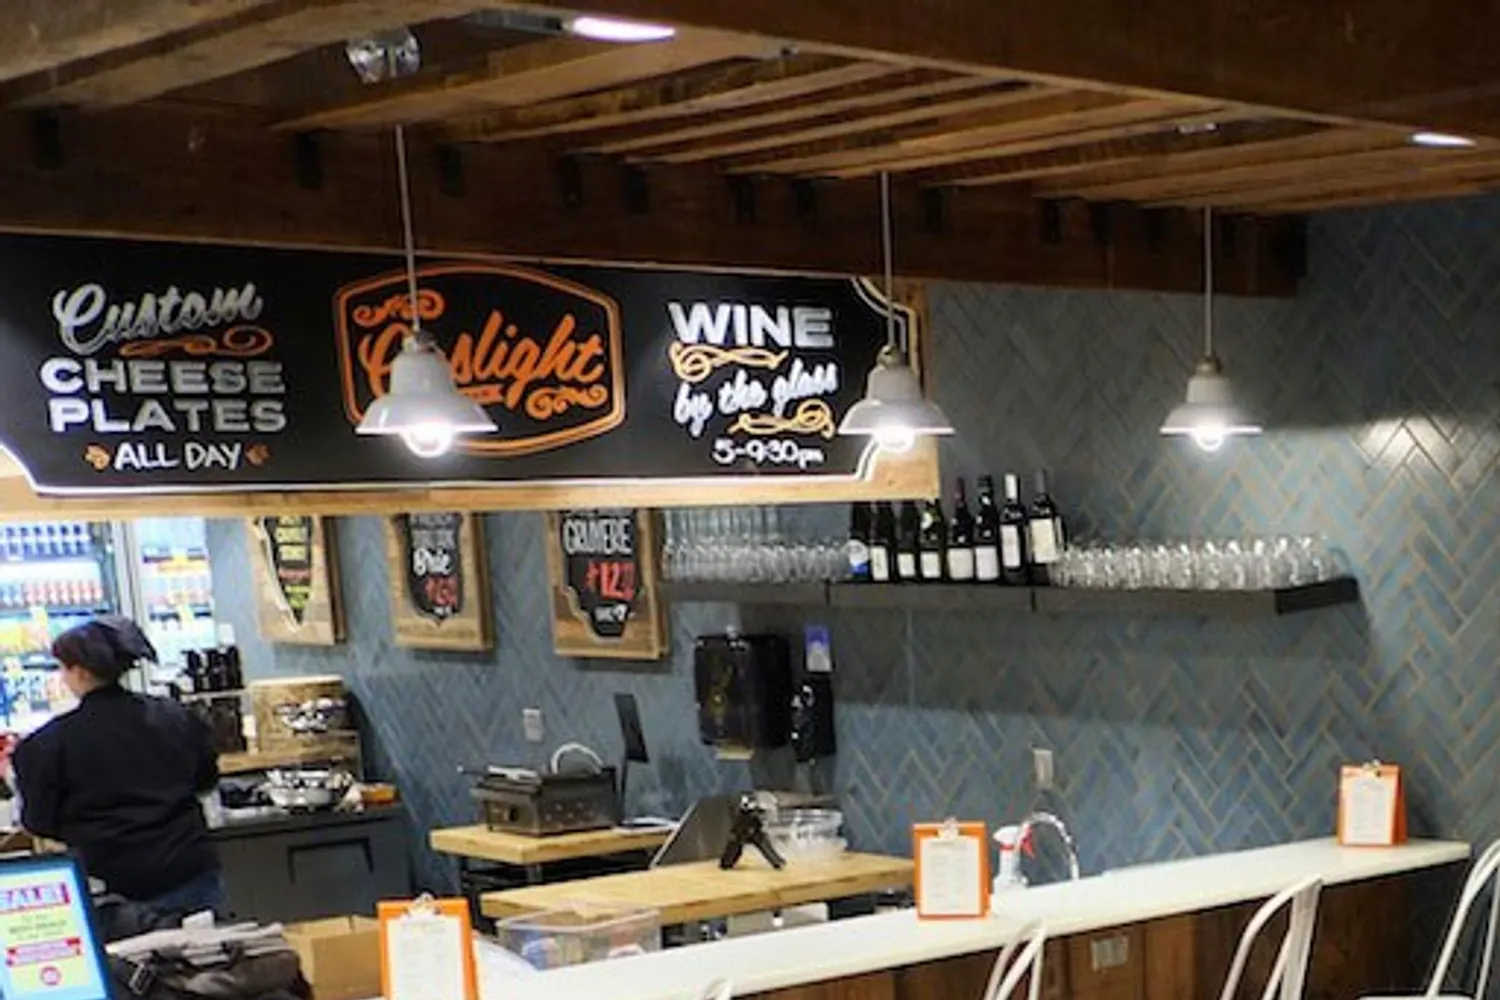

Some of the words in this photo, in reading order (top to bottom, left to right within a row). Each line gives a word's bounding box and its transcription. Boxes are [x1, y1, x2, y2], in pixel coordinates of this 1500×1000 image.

[52, 283, 263, 355] Custom
[668, 302, 834, 348] WINE
[41, 358, 286, 394] CHEESE
[358, 310, 604, 409] Gslight
[49, 398, 286, 433] PLATES
[674, 381, 714, 437] by
[718, 368, 768, 415] the
[771, 357, 839, 418] glass
[114, 441, 180, 470] ALL
[185, 442, 242, 470] DAY
